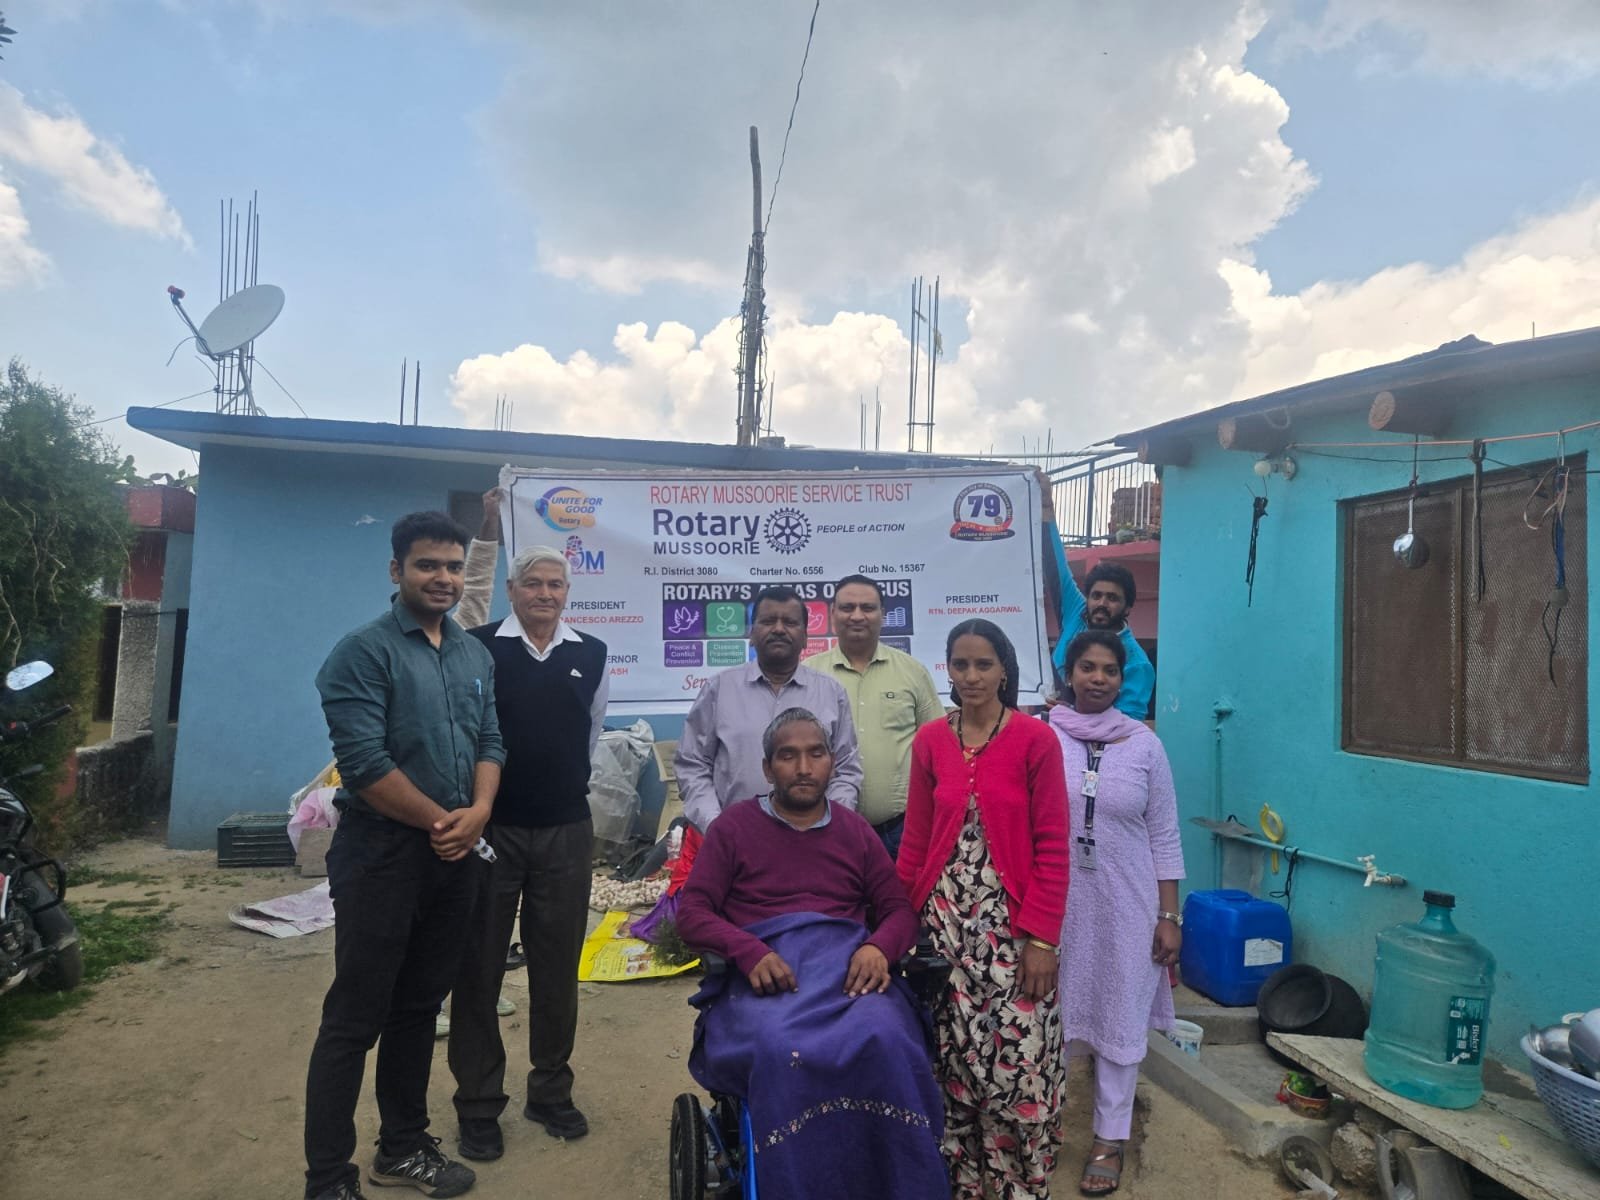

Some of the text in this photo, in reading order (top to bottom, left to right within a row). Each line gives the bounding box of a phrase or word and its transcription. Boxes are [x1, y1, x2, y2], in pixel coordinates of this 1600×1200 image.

[650, 483, 912, 504] ROTARY MUSSOORIE SERVICE TRUST
[582, 497, 603, 505] FOR
[968, 494, 1000, 517] 79
[653, 509, 760, 542] Rotary
[816, 525, 855, 533] PEOPLE
[870, 523, 905, 532] ACTION
[653, 541, 760, 555] MUSSOORIE
[644, 566, 718, 576] R.I. District 3080
[750, 566, 824, 576] Charter No. 6556
[858, 564, 926, 574] Club No. 15367
[664, 585, 751, 600] ROTARY'S
[823, 583, 837, 599] O
[875, 581, 910, 597] CUS
[946, 594, 1000, 604] PRESIDENT
[570, 601, 626, 610] PRESIDENT
[948, 607, 979, 615] DEEPAK
[979, 606, 1022, 614] AGGARWAL
[560, 615, 643, 624] ANCESCO AREZZO
[607, 655, 639, 664] ERNOR
